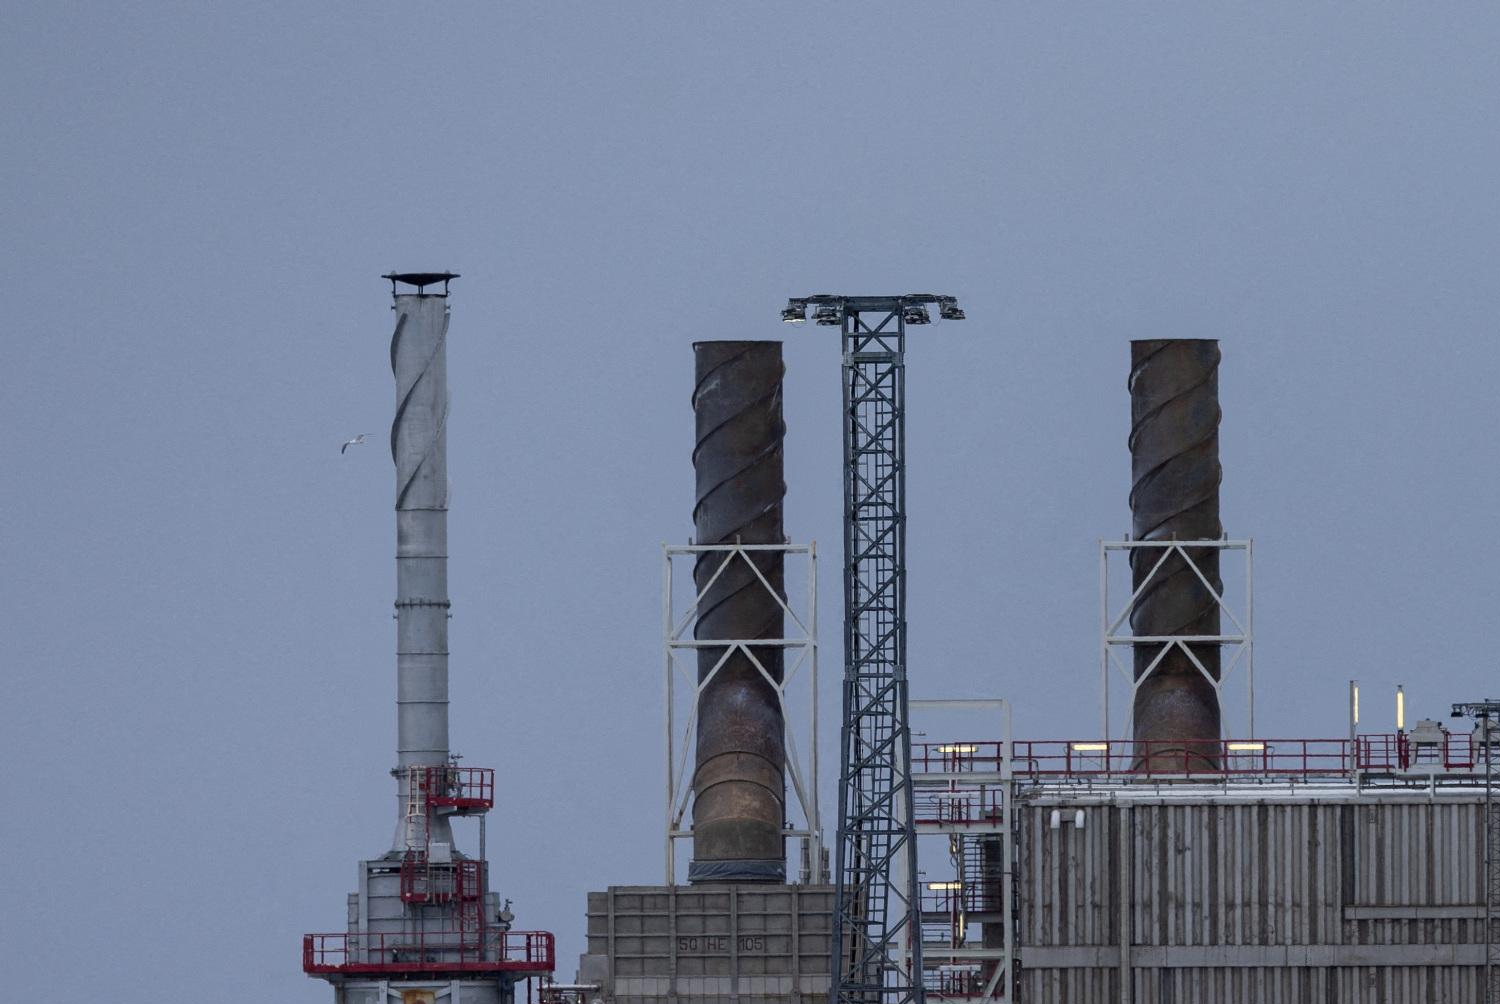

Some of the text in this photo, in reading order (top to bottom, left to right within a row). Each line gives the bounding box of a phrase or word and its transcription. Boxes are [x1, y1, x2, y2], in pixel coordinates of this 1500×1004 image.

[679, 936, 763, 951] 50 HE 105
